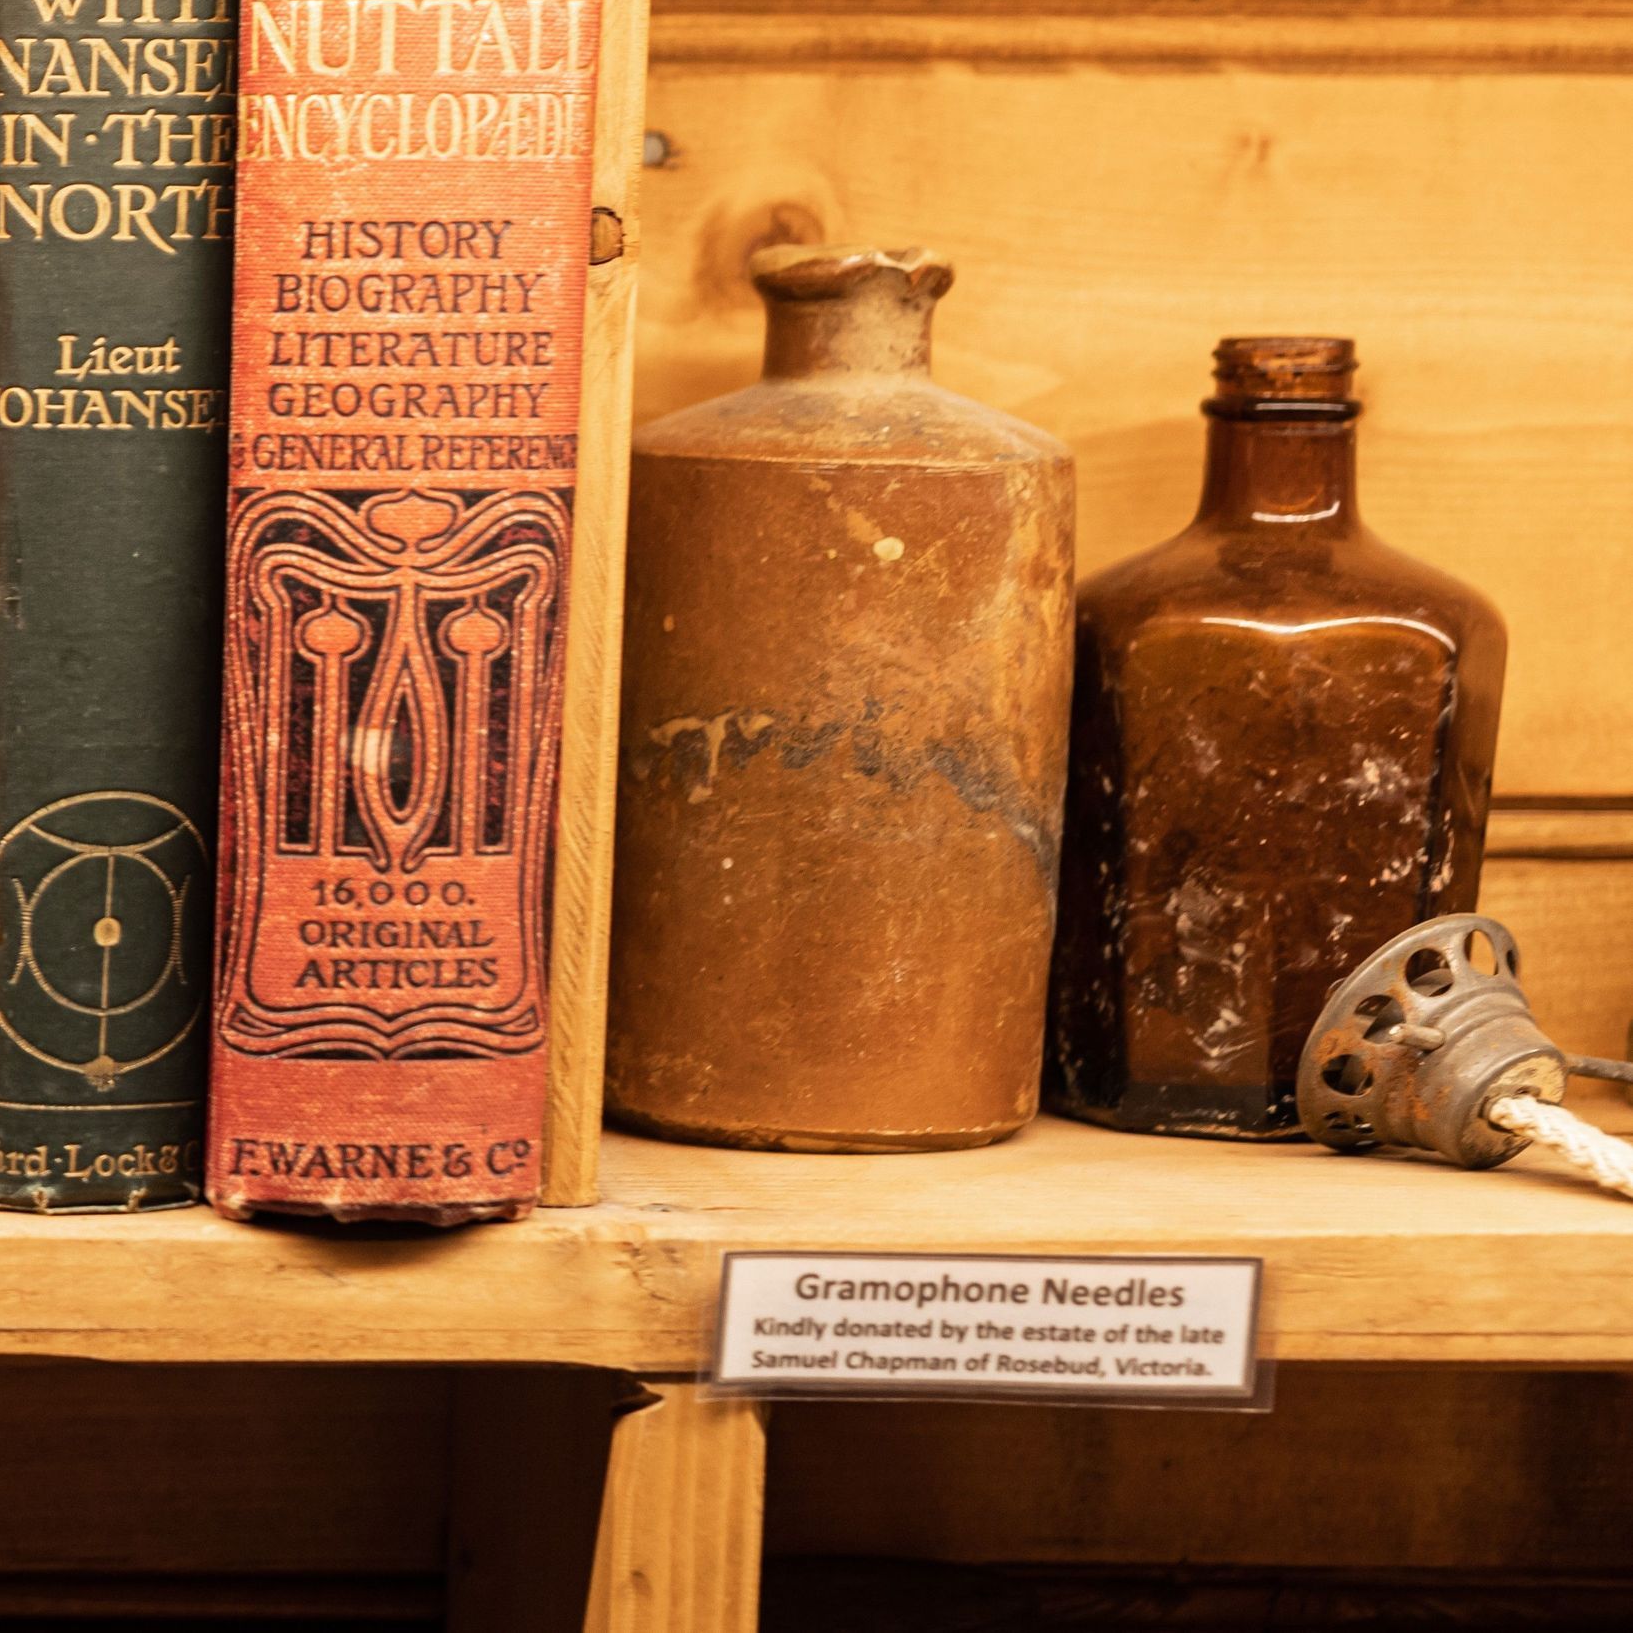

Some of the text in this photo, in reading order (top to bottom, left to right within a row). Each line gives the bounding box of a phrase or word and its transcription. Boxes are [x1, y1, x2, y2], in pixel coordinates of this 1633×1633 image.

[301, 221, 512, 259] HISTORY
[273, 274, 545, 313] BIOGRAPHY
[55, 335, 182, 381] Lieut
[269, 332, 553, 367] LITERATURE
[267, 382, 550, 417] GEOGRAPHY
[251, 434, 413, 472] GENERAL
[298, 921, 494, 948] ORIGINAL
[294, 957, 498, 988] ARTICLES
[63, 1144, 159, 1180] Lock
[441, 1143, 473, 1178] &
[795, 1273, 1185, 1308] Gramophone Needles
[754, 1317, 1225, 1345] Kindly donated by the estate of the late
[751, 1350, 1213, 1379] Samuel Chapman of Rosebud, Victoria.
